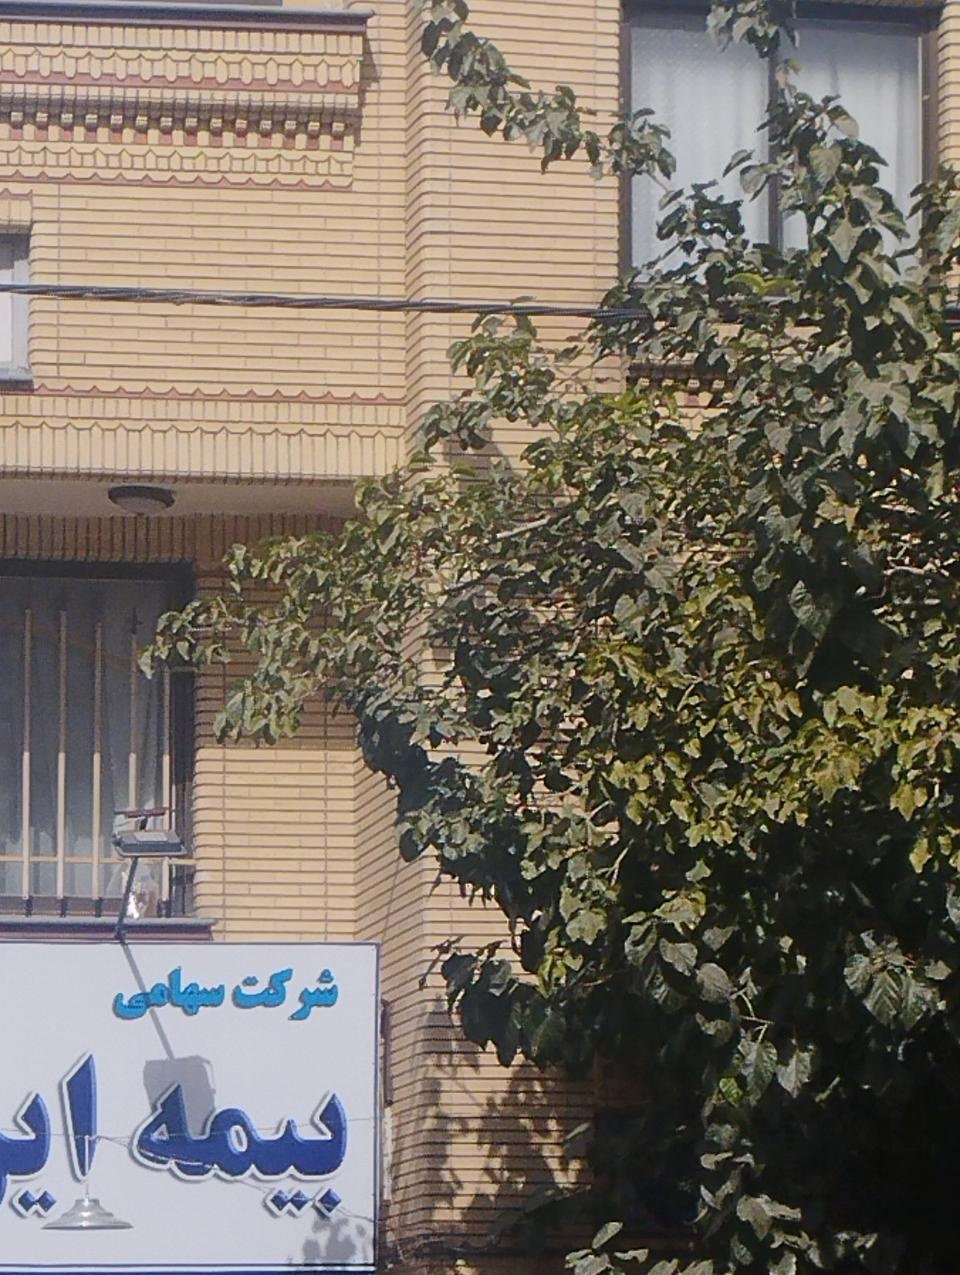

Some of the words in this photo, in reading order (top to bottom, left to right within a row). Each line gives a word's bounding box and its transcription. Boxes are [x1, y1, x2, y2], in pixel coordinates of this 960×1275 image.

[113, 966, 225, 1020] سهامی
[232, 968, 338, 1020] شرکت
[134, 1082, 348, 1215] بیمه
